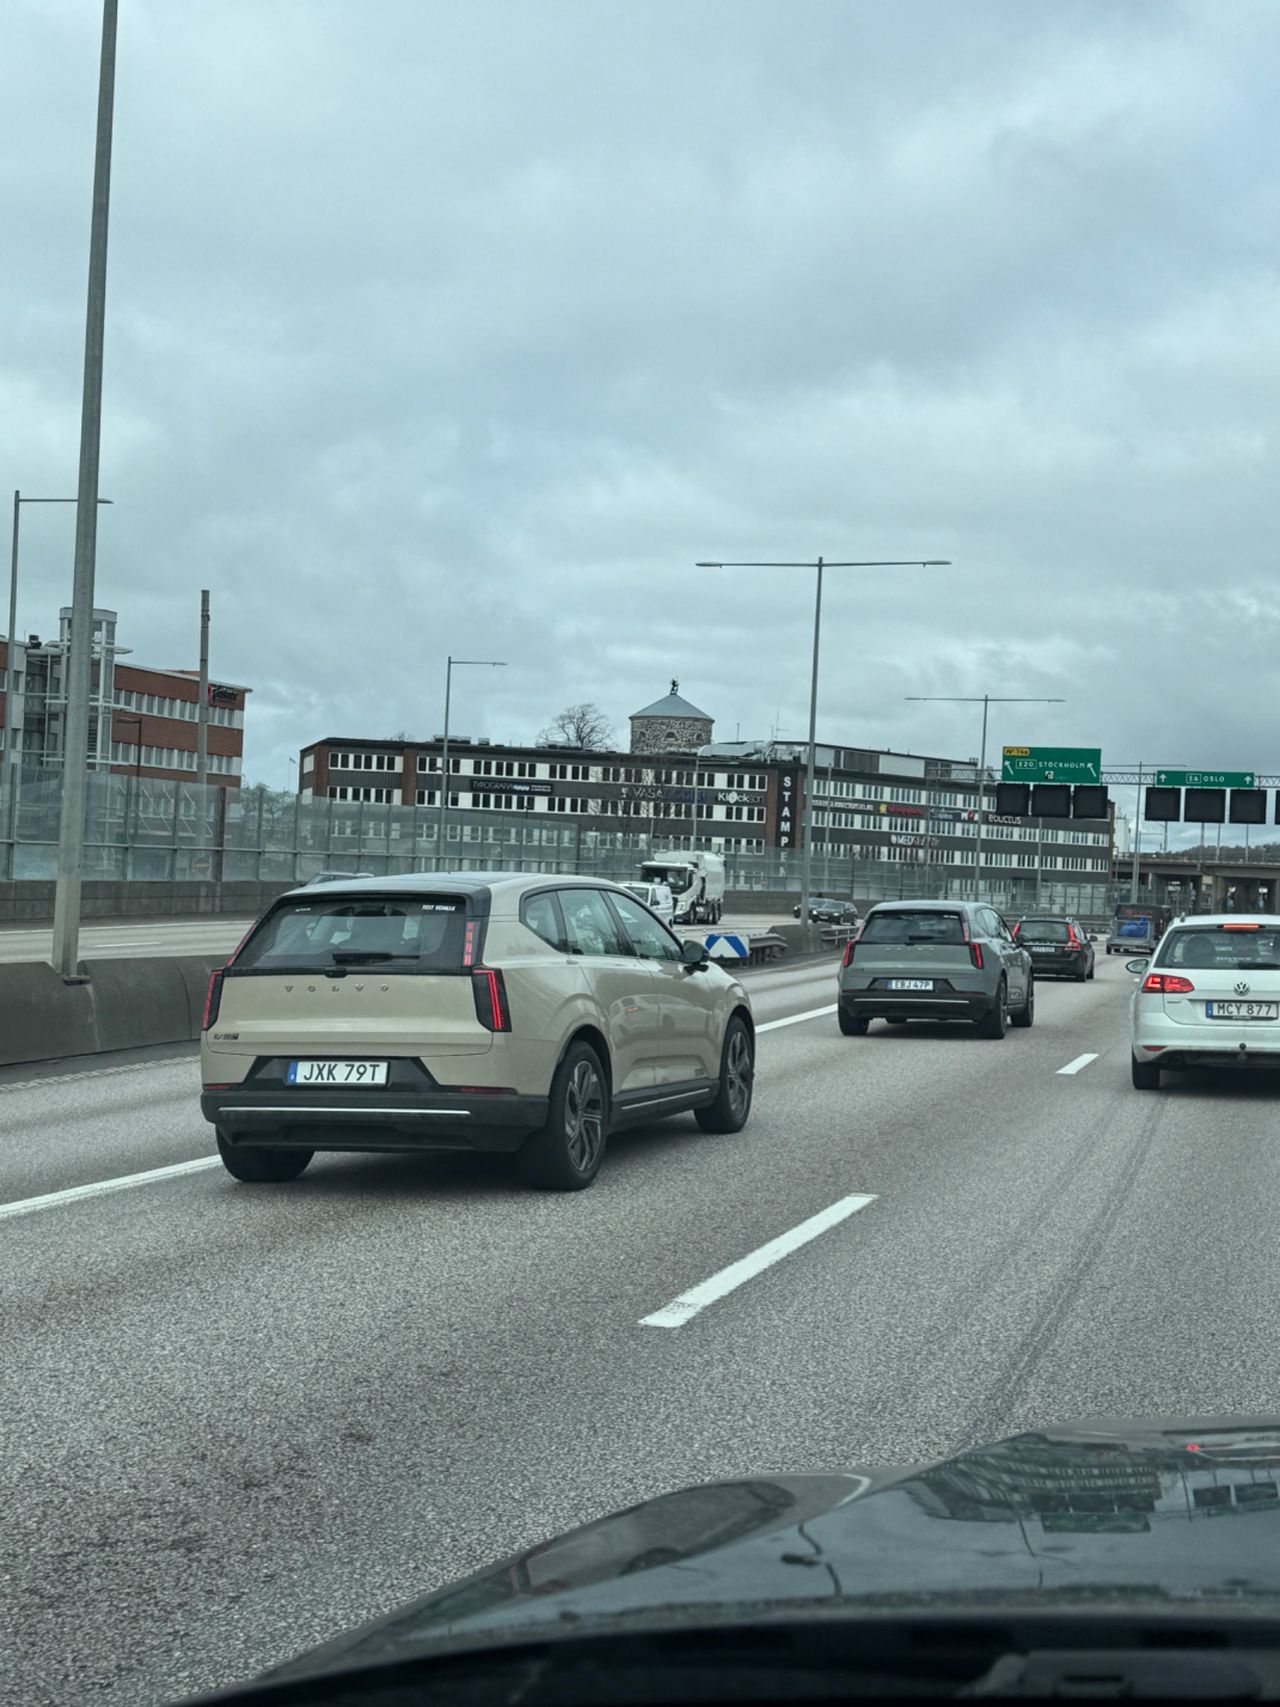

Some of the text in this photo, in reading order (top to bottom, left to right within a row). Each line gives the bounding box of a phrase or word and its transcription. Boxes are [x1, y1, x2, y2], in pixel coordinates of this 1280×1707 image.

[1038, 761, 1086, 769] STOCKHOLM
[1202, 775, 1226, 783] OSLO
[284, 983, 389, 993] VOLVO
[894, 979, 931, 990] EBJ 47P
[1217, 1003, 1272, 1016] MCY 877
[303, 1063, 381, 1082] JXK 79T
